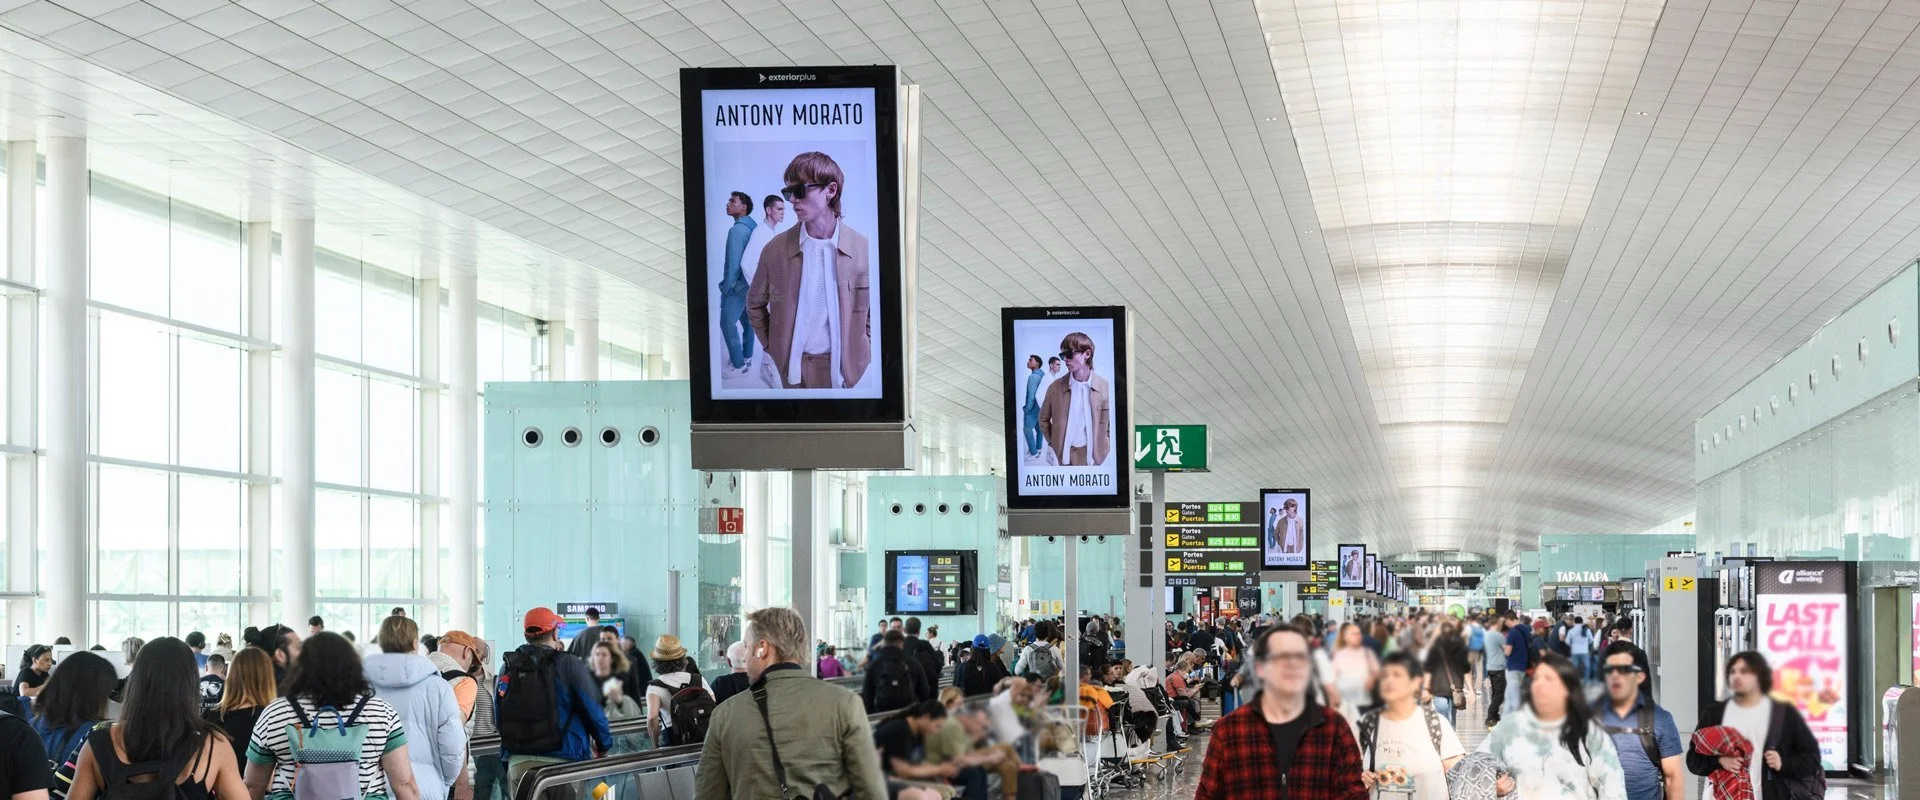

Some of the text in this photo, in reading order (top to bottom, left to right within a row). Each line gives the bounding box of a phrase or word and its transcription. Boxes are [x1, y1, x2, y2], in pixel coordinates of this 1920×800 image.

[768, 73, 816, 81] exteriorplus
[715, 103, 863, 126] ANTONY MORATO
[1025, 474, 1110, 487] ANTONY MORATO
[1556, 571, 1609, 582] TAPA TAPA
[1766, 603, 1839, 626] LAST
[1767, 629, 1835, 653] CALL
